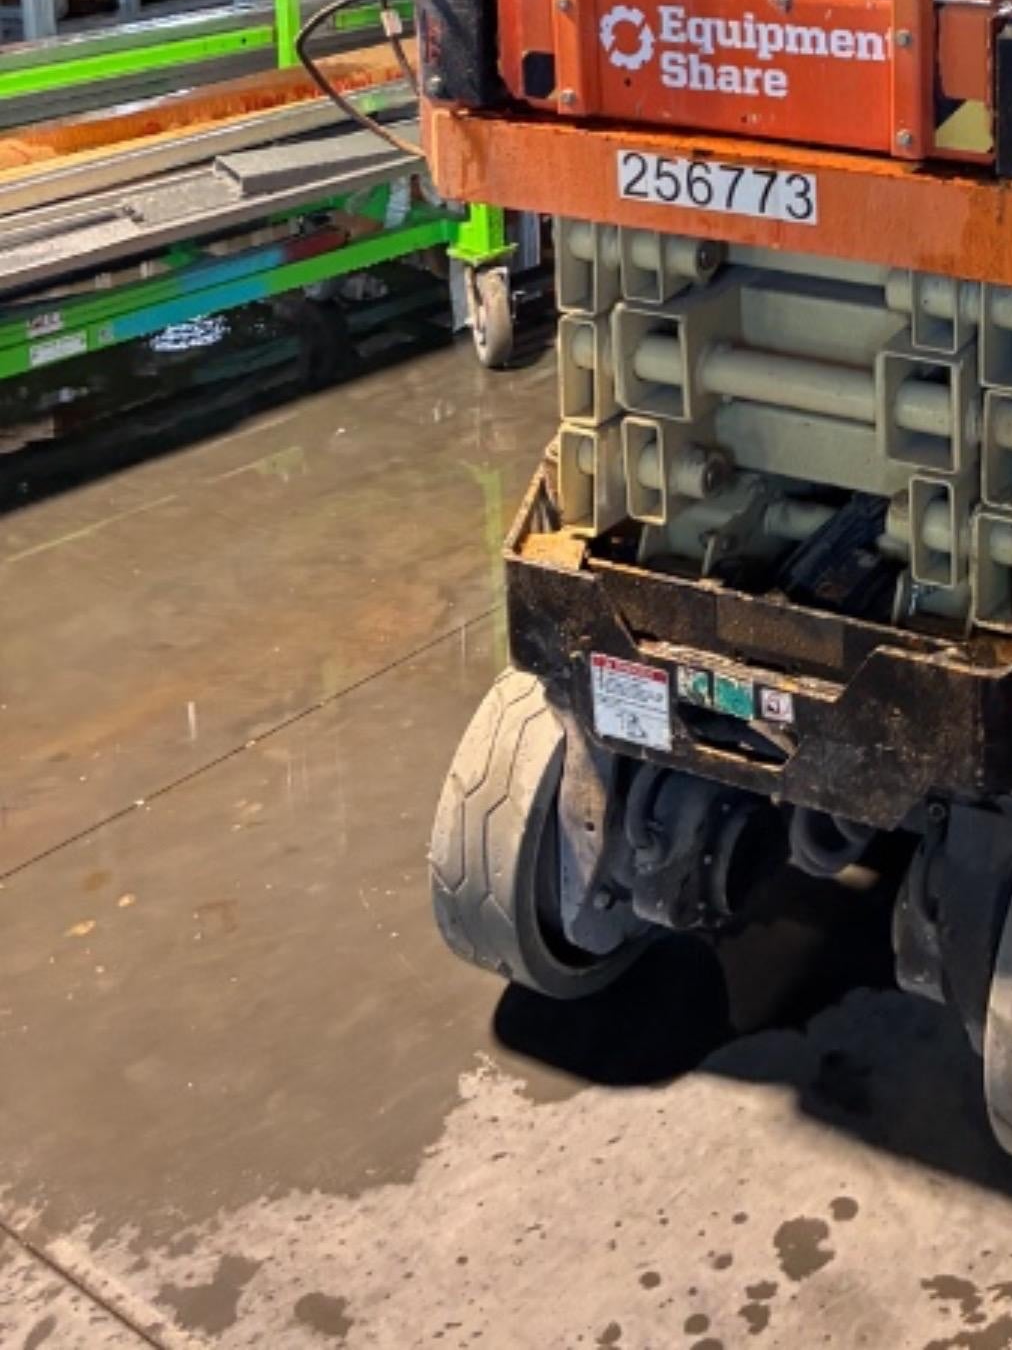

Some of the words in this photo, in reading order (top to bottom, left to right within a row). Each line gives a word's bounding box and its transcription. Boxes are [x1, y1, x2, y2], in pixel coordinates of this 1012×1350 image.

[658, 5, 893, 61] Equipmen
[659, 51, 789, 97] Share
[622, 152, 814, 219] 256773
